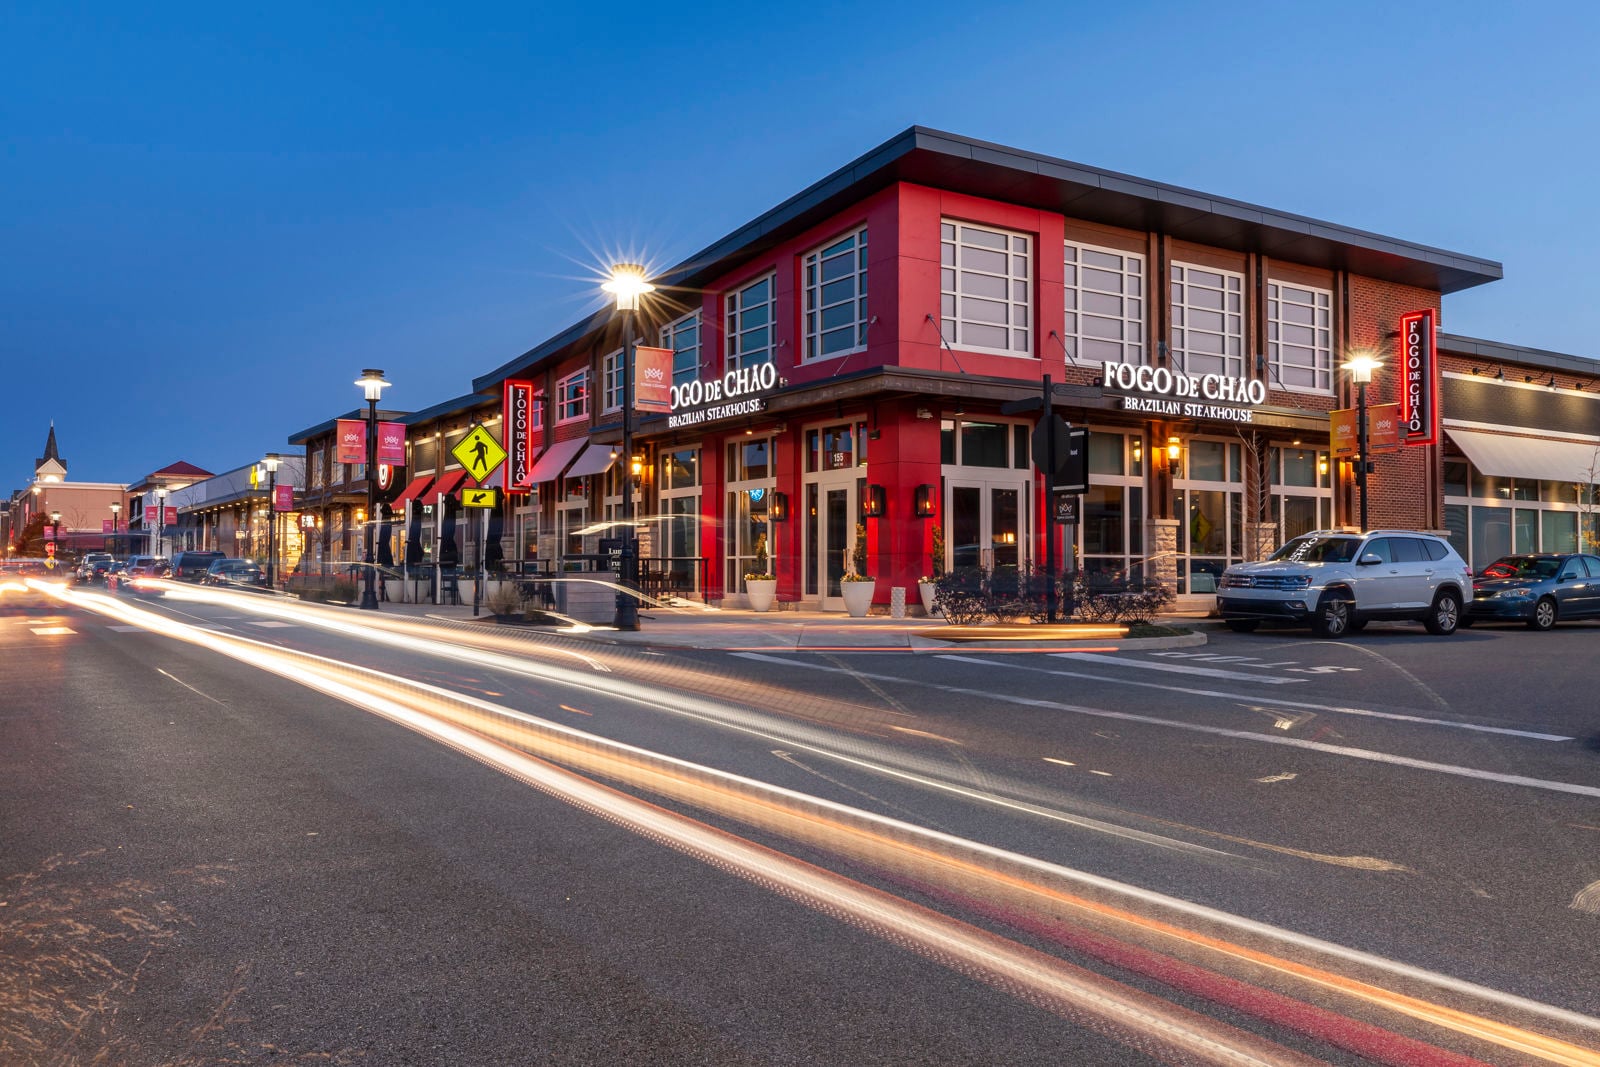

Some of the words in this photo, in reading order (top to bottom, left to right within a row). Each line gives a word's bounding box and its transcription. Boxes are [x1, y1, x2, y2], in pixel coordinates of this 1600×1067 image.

[1408, 321, 1420, 369] FOGO
[669, 380, 703, 409] OGO
[704, 379, 722, 402] DE
[724, 362, 776, 397] CHÃO
[1104, 361, 1172, 394] FOGO
[1176, 375, 1199, 397] DE
[1202, 374, 1266, 404] CHÃO
[1408, 372, 1420, 381] DE
[516, 389, 527, 430] FOGO
[668, 410, 705, 428] BRAZILIAN
[707, 398, 760, 421] STEAKHOUSE
[1125, 397, 1181, 414] BRAZILIAN
[1184, 403, 1253, 422] STEAKHOUSE
[1409, 383, 1420, 431] CHÃO
[834, 452, 844, 463] 155
